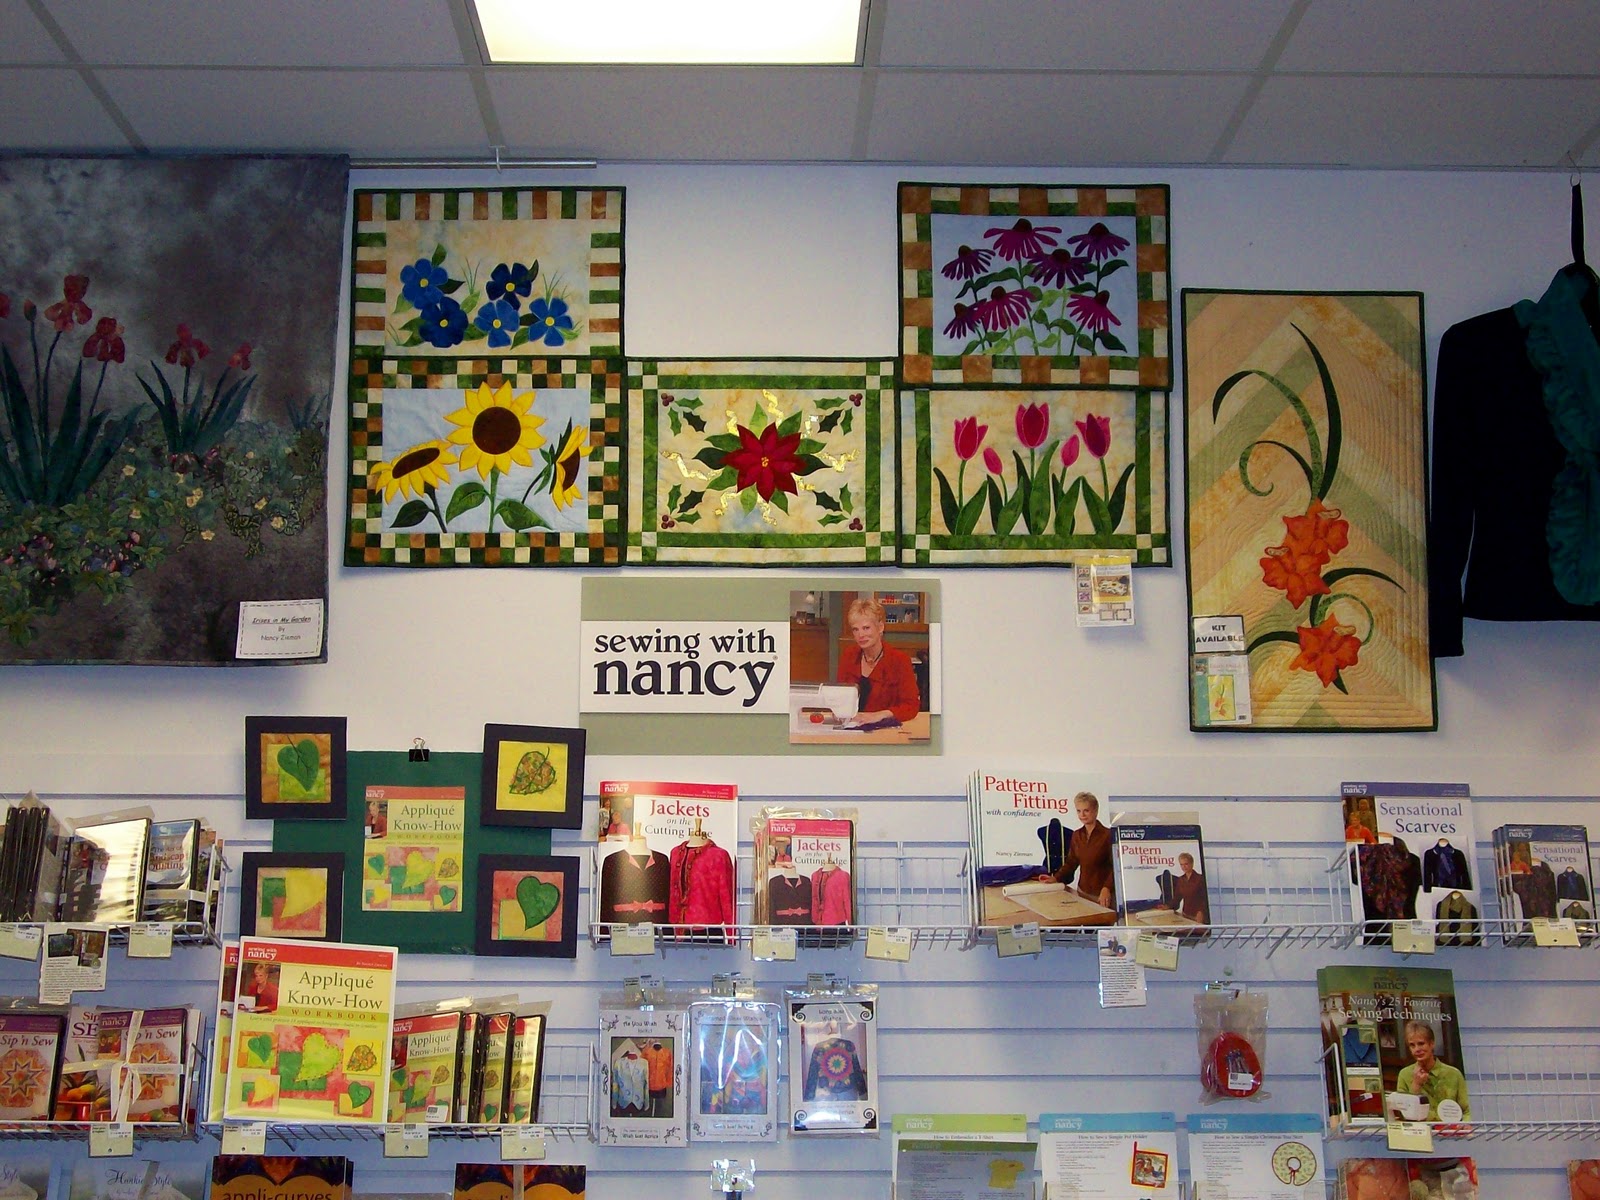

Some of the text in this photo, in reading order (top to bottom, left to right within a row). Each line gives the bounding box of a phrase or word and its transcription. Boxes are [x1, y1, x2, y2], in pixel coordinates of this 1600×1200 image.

[593, 627, 777, 660] sewing with
[1195, 634, 1245, 644] AVAILABLE
[592, 658, 776, 708] nancy
[604, 785, 629, 794] nancy
[984, 775, 1048, 794] Pattern
[1343, 786, 1367, 795] nancy
[649, 799, 710, 818] Jackets
[1012, 792, 1069, 814] Fitting
[1379, 802, 1463, 817] Sensational
[400, 804, 455, 819] Appliqué
[986, 808, 1042, 818] with confidence
[393, 819, 462, 832] Know-How
[679, 817, 692, 826] the
[1394, 818, 1457, 834] Scarves
[644, 824, 713, 841] Cutting Edge
[770, 825, 796, 834] nancy
[1120, 831, 1146, 840] nancy
[1508, 830, 1533, 839] nancy
[796, 838, 842, 853] Jackets
[1121, 844, 1162, 855] Pattern
[1532, 844, 1584, 855] Sensational
[995, 850, 1012, 859] Nancy
[1139, 855, 1175, 867] Fitting
[1543, 853, 1577, 863] Scarves
[794, 856, 848, 867] Cutting Edge
[247, 950, 278, 961] nancy
[298, 970, 375, 992] Appliqué
[1373, 981, 1409, 991] nancy
[287, 989, 383, 1011] Know-How
[1348, 995, 1442, 1008] Nancy's 25 Favorite
[291, 1008, 378, 1022] WORKBOOK
[1338, 1006, 1452, 1024] Sewing Techniques
[102, 1018, 128, 1027] nancy
[72, 1022, 99, 1037] SE
[124, 1029, 142, 1041] Sp
[155, 1028, 179, 1040] Sew
[1, 1034, 55, 1048] Sip 'n Sew
[408, 1044, 451, 1058] Know-How
[906, 1120, 933, 1131] nancy
[1054, 1120, 1082, 1131] nancy
[1200, 1120, 1229, 1131] nancy
[221, 1187, 332, 1200] appli-curves
